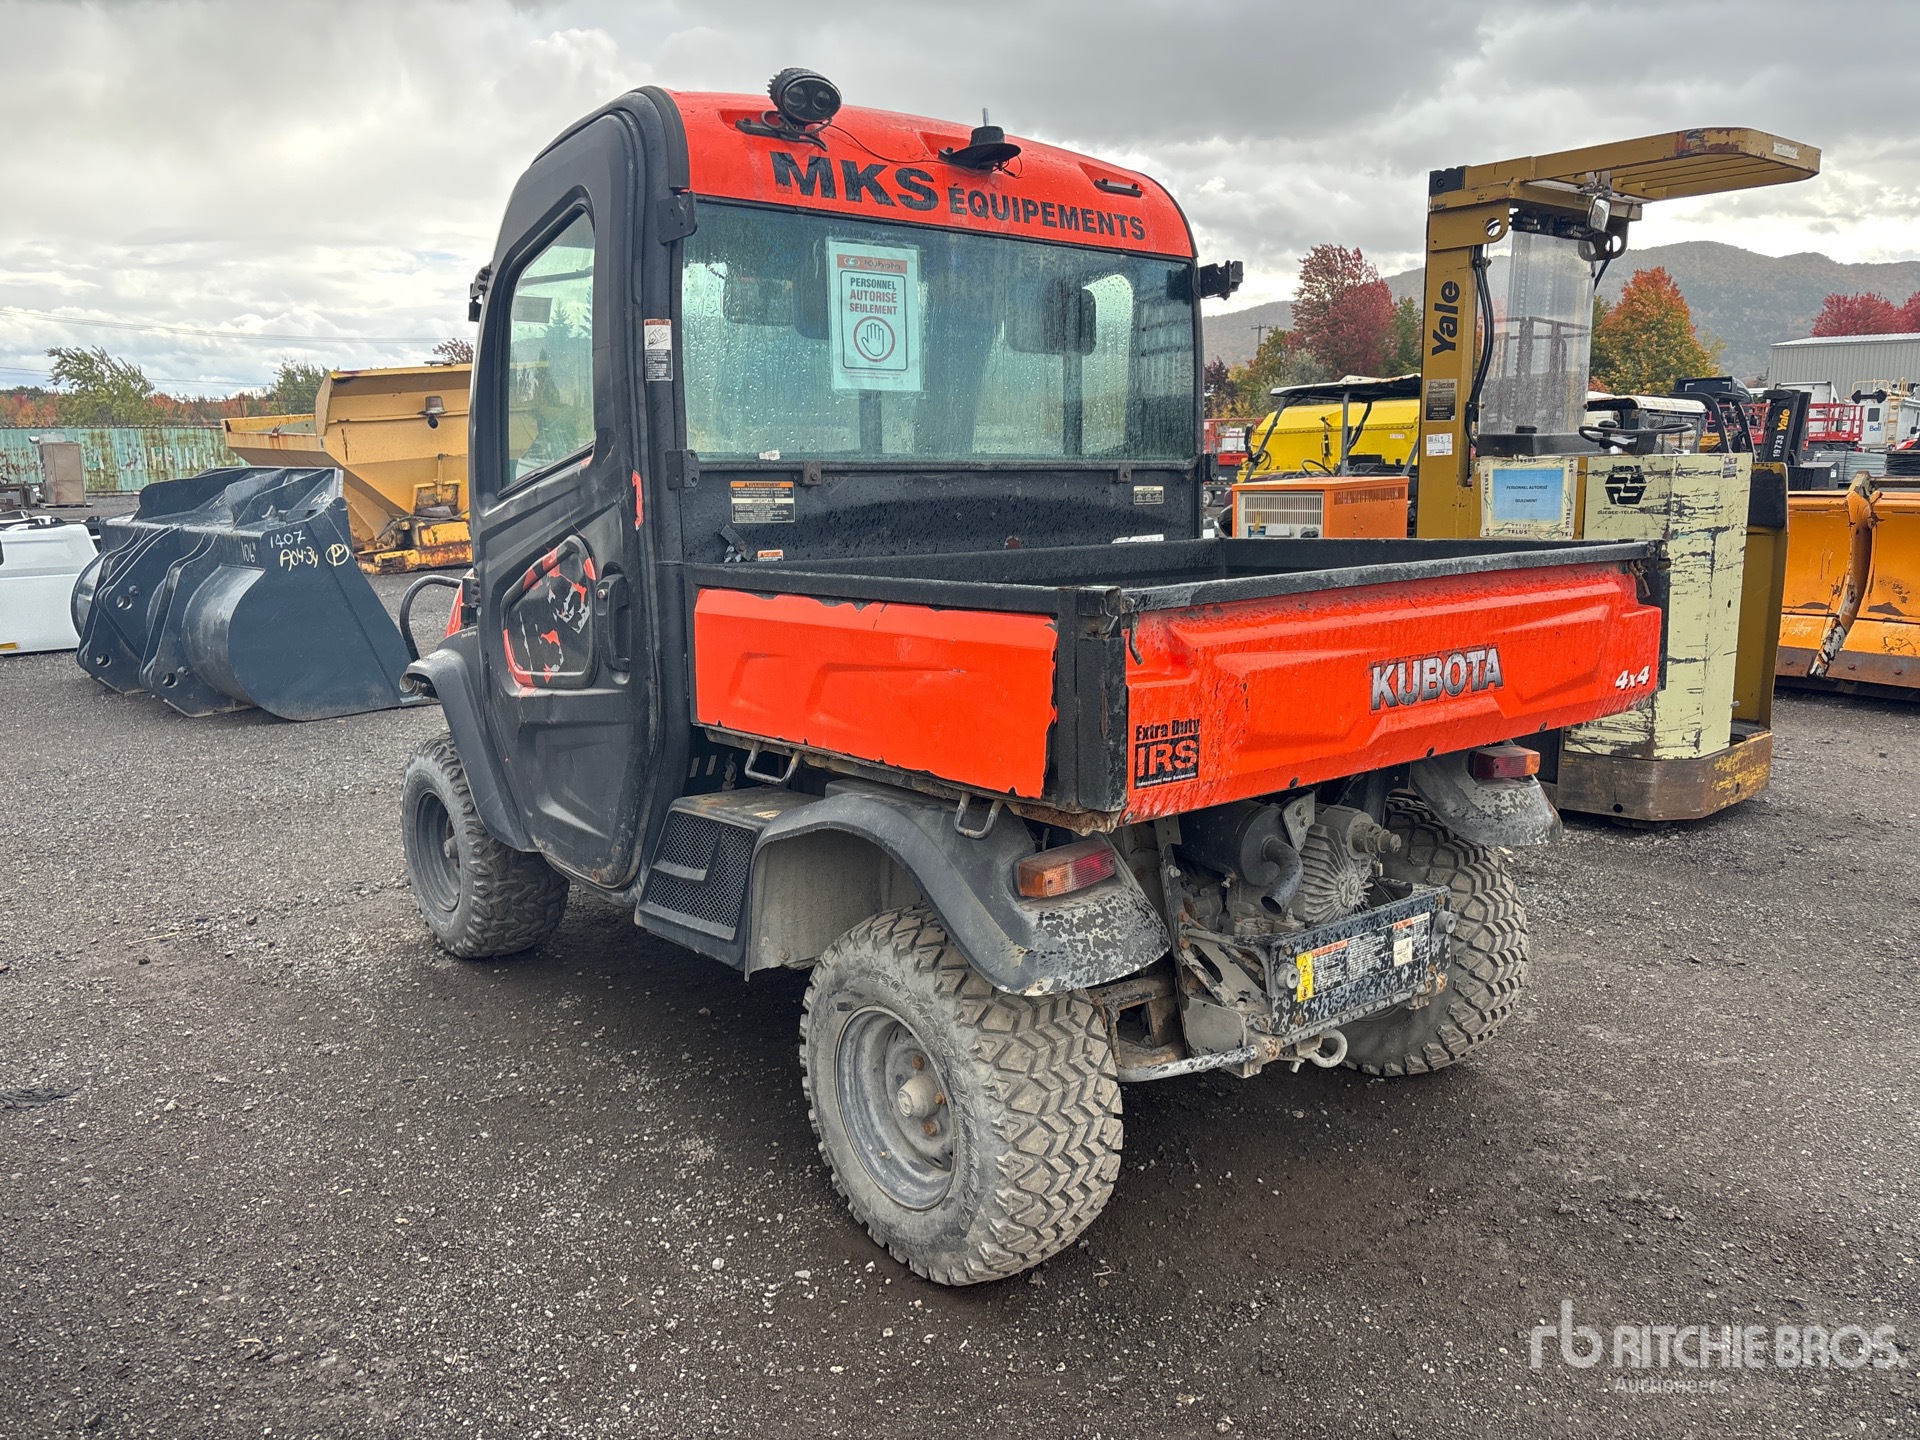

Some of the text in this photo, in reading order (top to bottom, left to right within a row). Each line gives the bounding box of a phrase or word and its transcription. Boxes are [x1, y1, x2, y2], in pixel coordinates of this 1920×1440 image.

[770, 151, 1147, 241] MKS ÉQUIPEMENTS
[864, 259, 901, 271] Kubota
[850, 277, 896, 290] PERSONNEL
[849, 289, 897, 304] AUTORISÉ
[849, 303, 898, 315] SEULEMENT
[1431, 280, 1460, 357] Yale
[1777, 409, 1790, 431] Yale
[1773, 435, 1784, 458] 19733
[270, 530, 306, 549] 1407
[1371, 646, 1503, 711] KUBOTA
[1615, 664, 1650, 690] 4x4
[1135, 718, 1201, 741] Extra Duty
[1137, 739, 1198, 777] IRS
